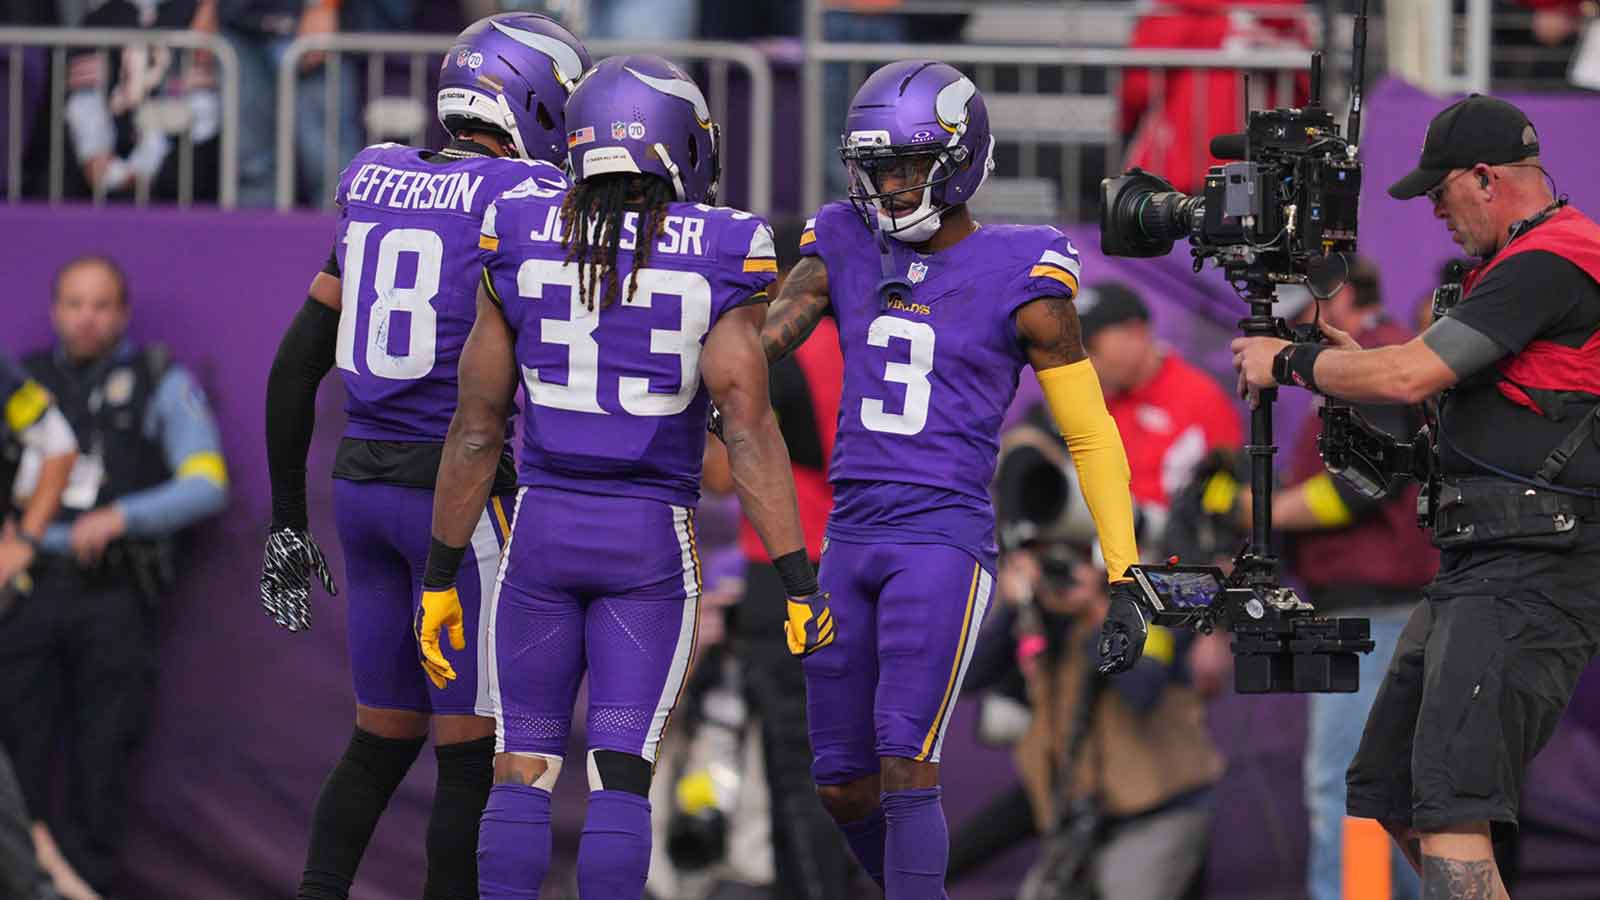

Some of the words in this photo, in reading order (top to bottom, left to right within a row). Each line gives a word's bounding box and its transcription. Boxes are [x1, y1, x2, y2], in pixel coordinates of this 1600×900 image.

[470, 55, 482, 66] 70
[630, 125, 643, 136] 70
[347, 164, 484, 212] JEFFERSON
[657, 216, 705, 256] SR
[335, 221, 443, 380] 18
[517, 259, 711, 416] 33
[860, 315, 936, 436] 3
